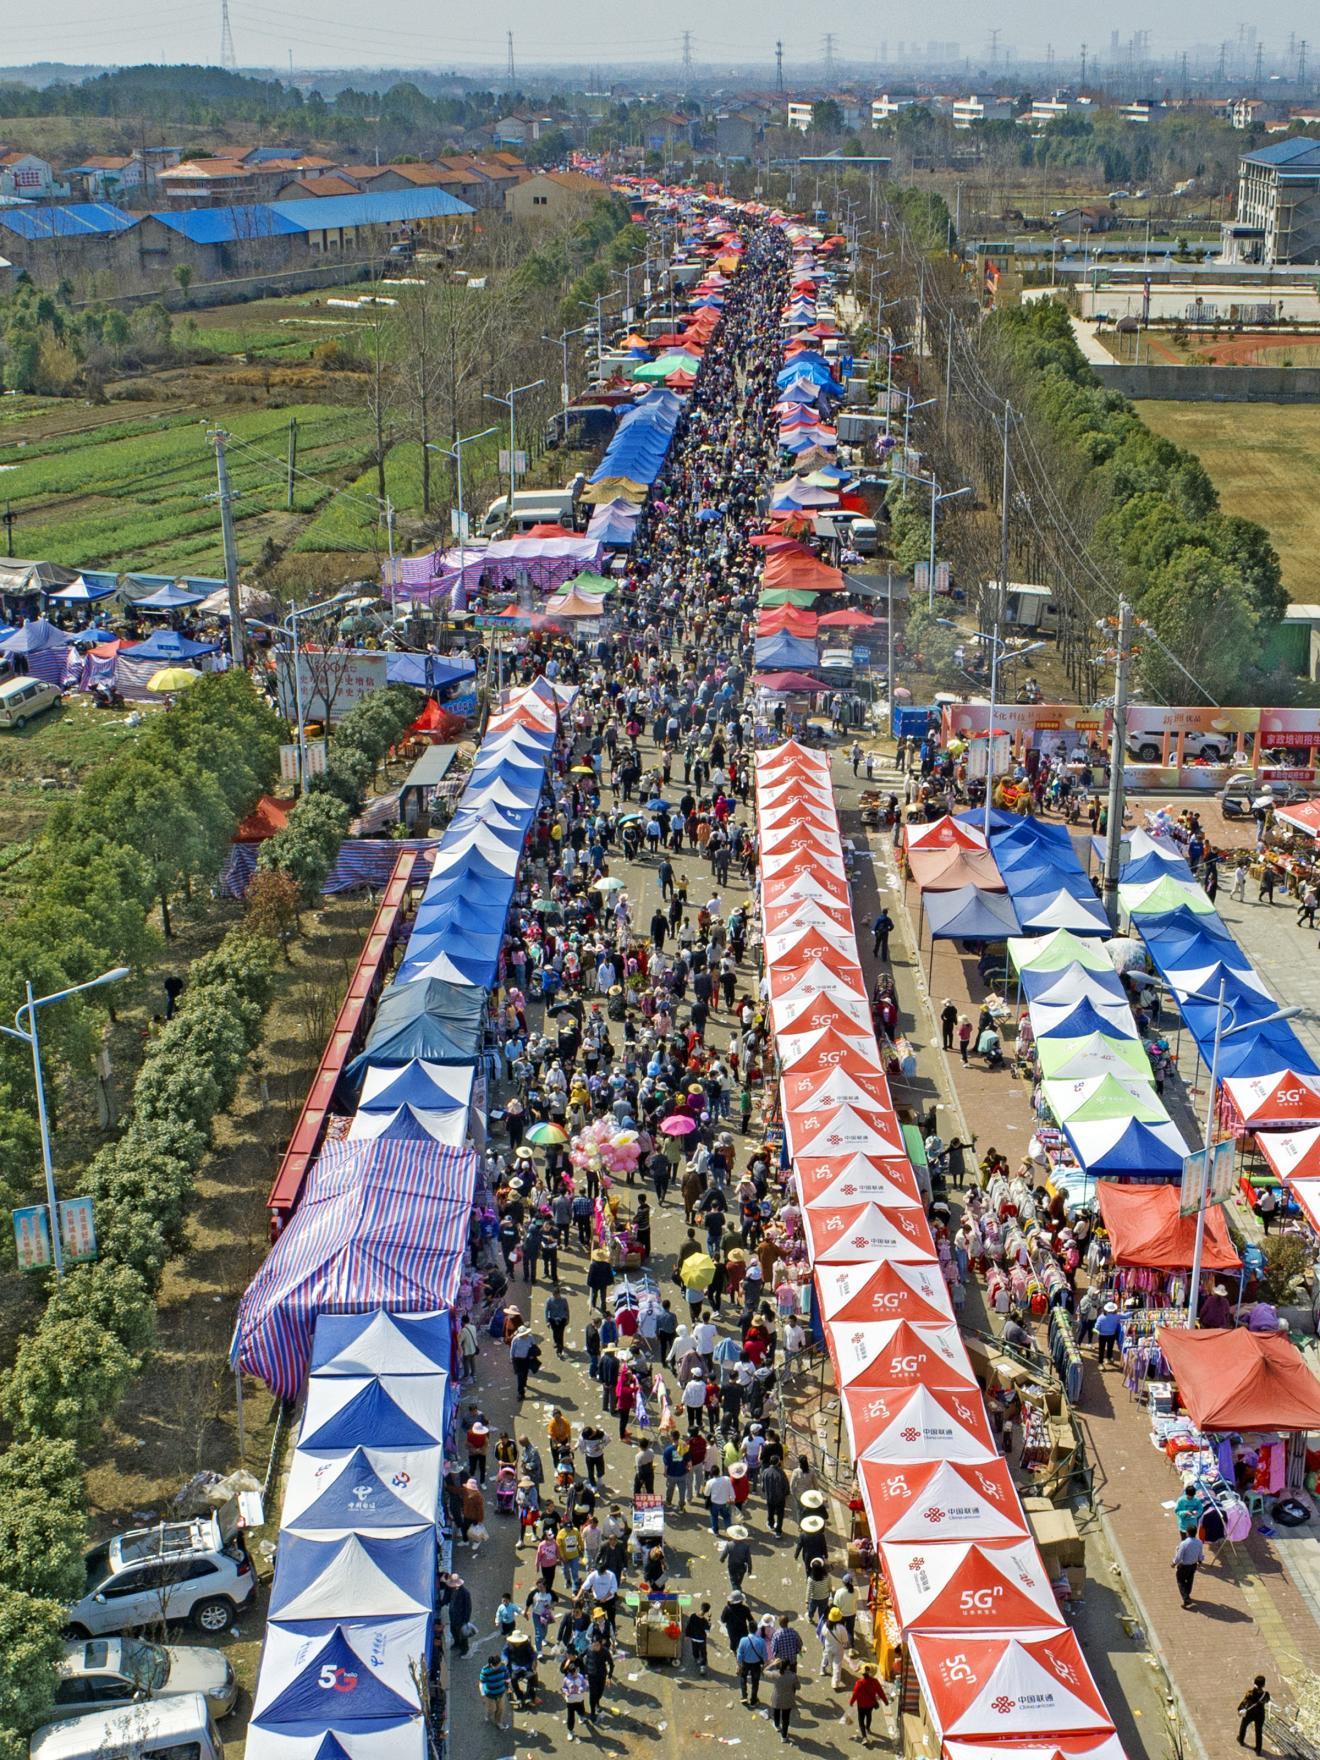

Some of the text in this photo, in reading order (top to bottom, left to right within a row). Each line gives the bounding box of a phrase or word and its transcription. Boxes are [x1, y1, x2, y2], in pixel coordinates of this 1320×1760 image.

[802, 946, 829, 957] 5Gn
[810, 1013, 839, 1026] 5Gn
[818, 1050, 847, 1063] 5Gn
[1276, 1088, 1307, 1103] 5Gn
[872, 1291, 908, 1307] 5Gn
[889, 1354, 927, 1373] 5Gn
[959, 1586, 1003, 1609] 5Gn
[318, 1664, 358, 1692] 5G
[1017, 1693, 1054, 1704] 中国联通
